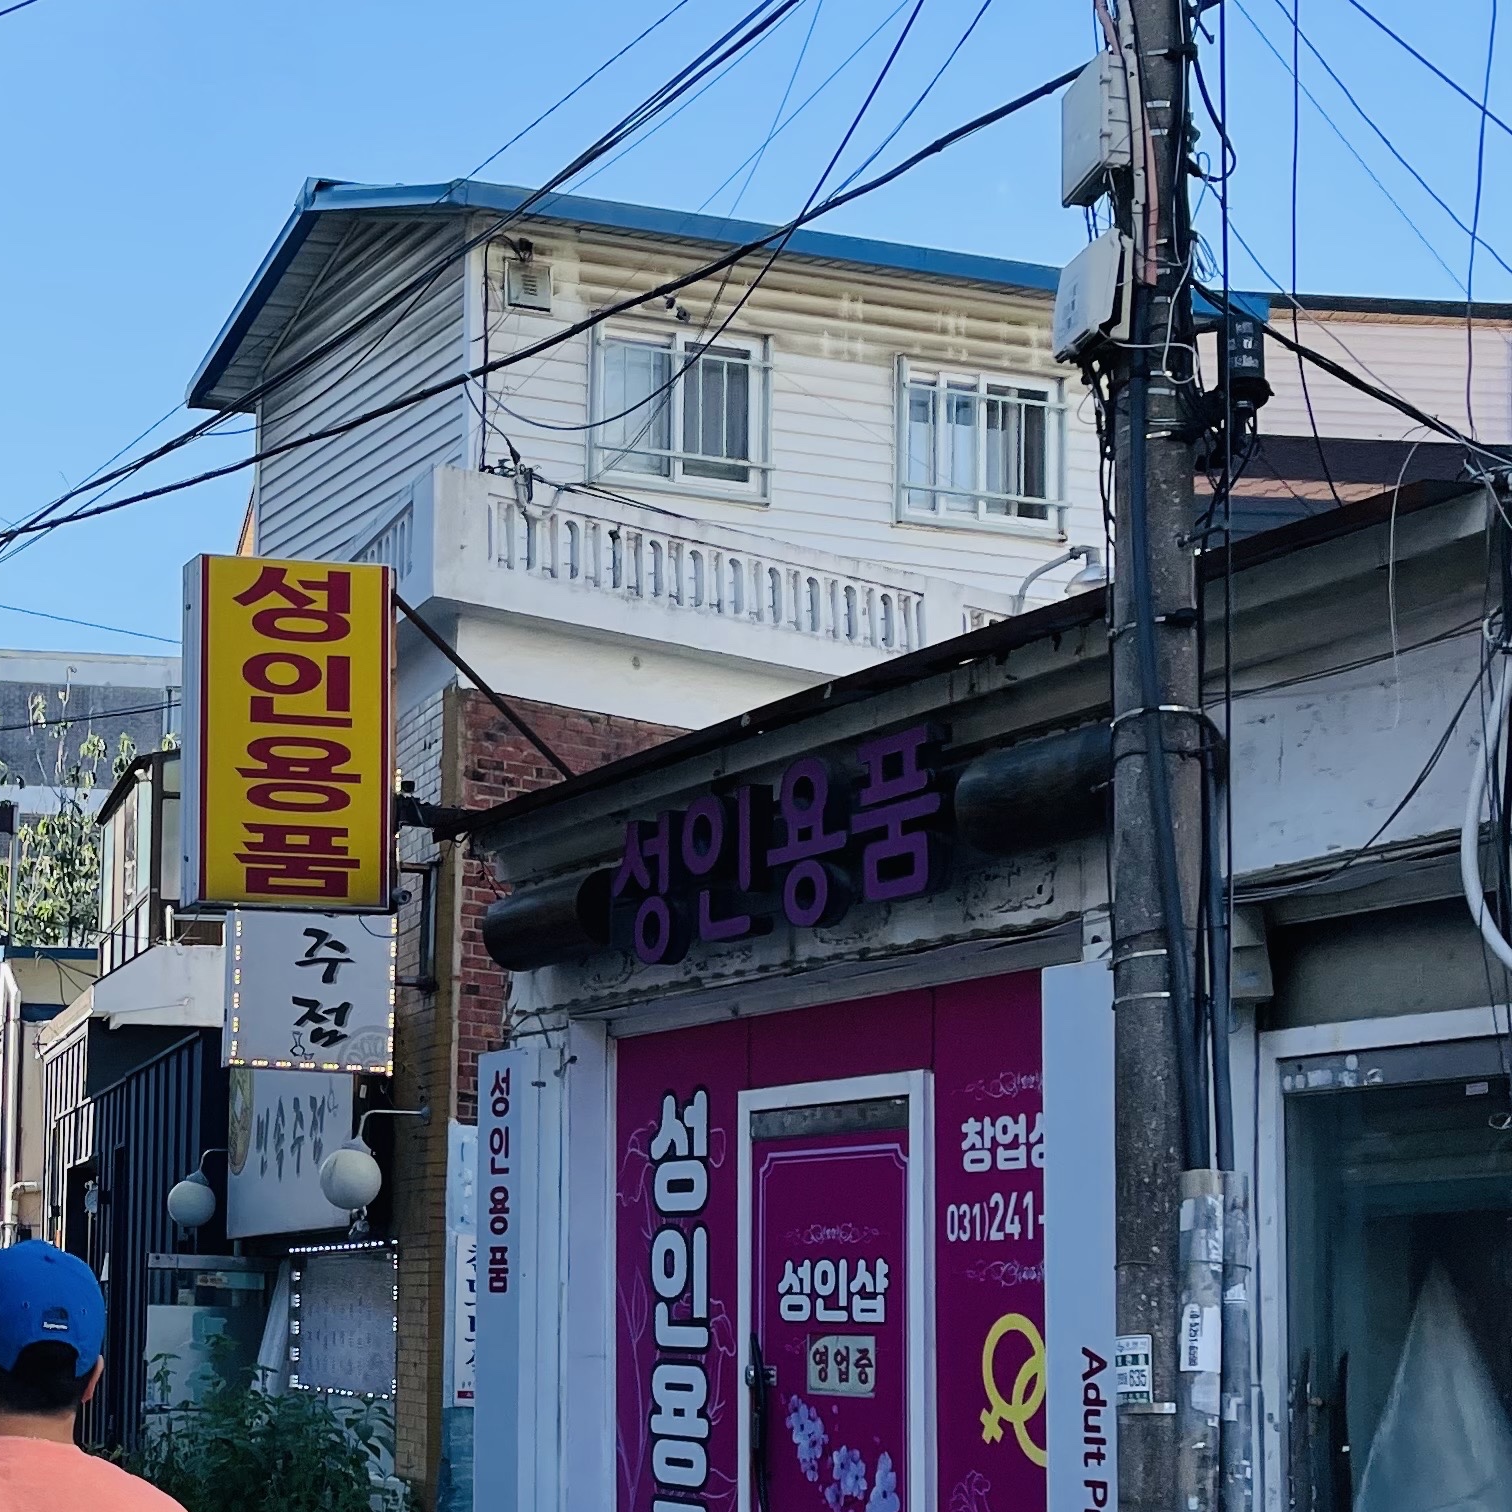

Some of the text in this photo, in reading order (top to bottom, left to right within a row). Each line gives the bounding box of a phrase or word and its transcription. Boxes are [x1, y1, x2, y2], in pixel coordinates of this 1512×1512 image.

[232, 566, 362, 898] 성인용품
[612, 724, 941, 966] 성인용품
[292, 927, 356, 1049] 주점
[489, 1066, 511, 1294] 성인용품
[778, 1259, 889, 1324] 성인샵
[811, 1349, 874, 1385] 영업중
[1080, 1346, 1108, 1469] Adult
